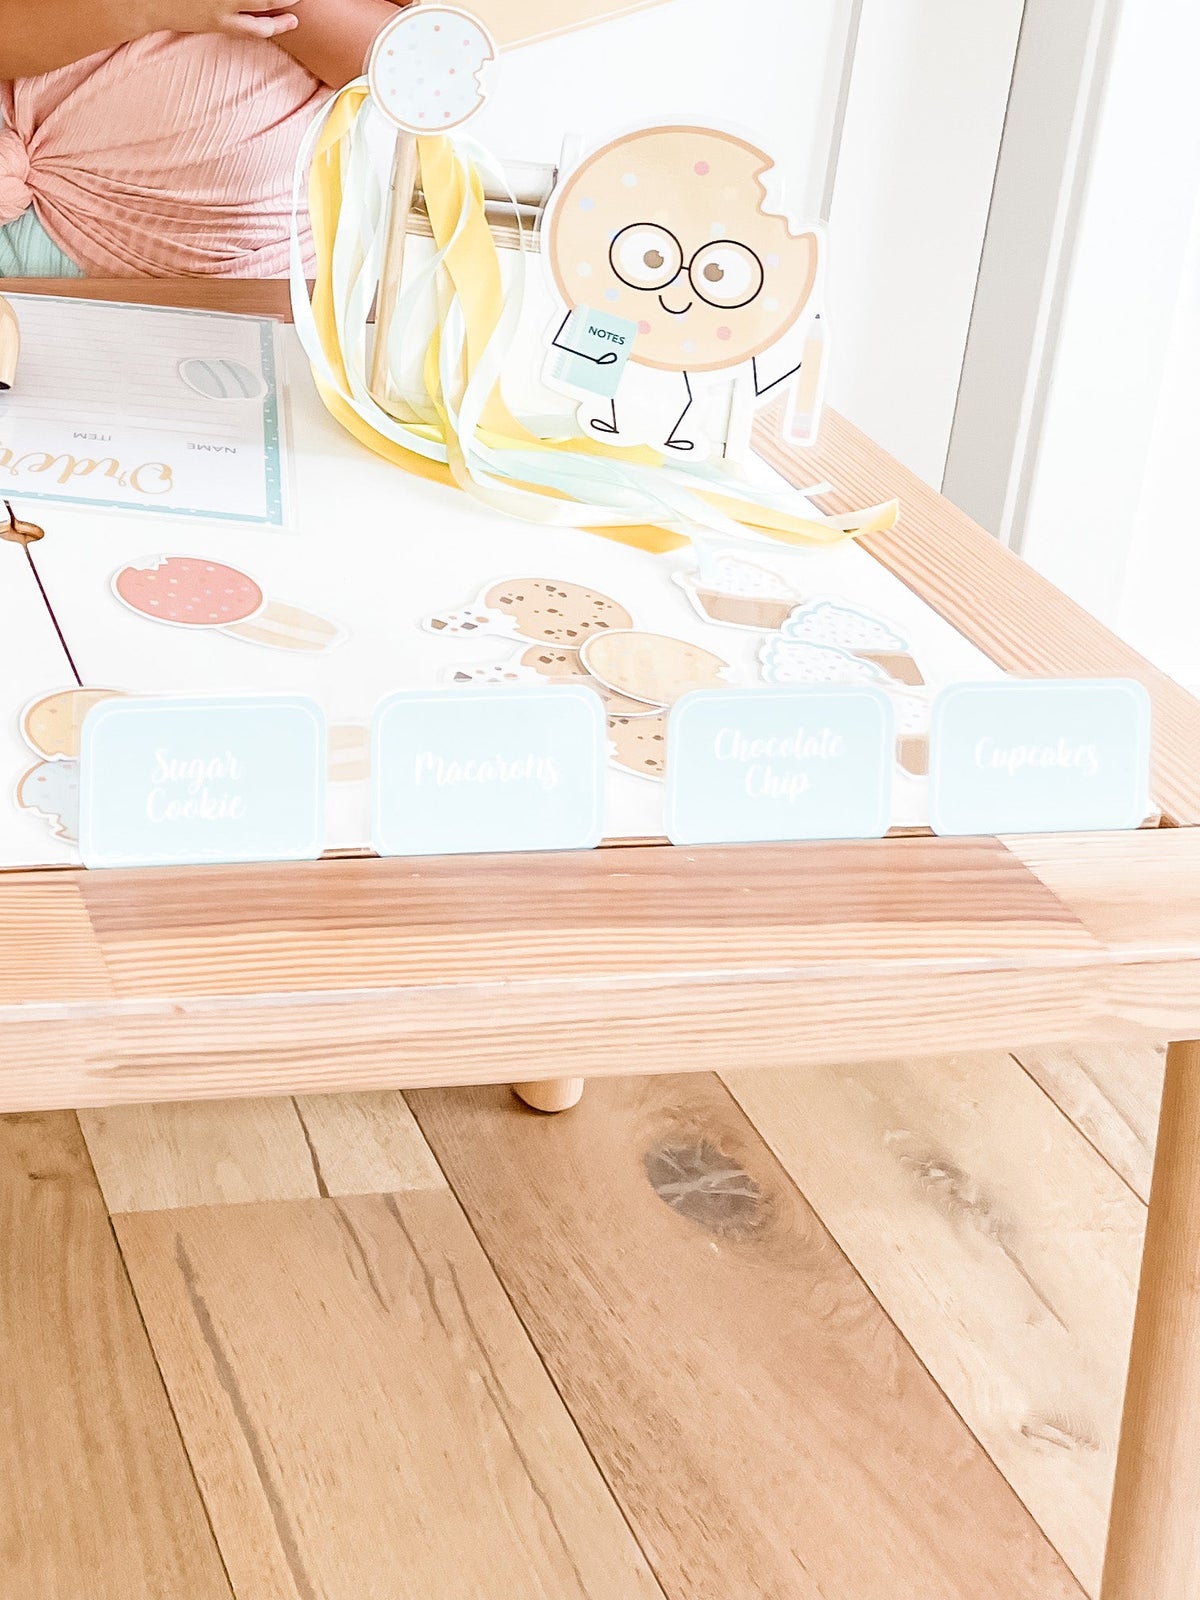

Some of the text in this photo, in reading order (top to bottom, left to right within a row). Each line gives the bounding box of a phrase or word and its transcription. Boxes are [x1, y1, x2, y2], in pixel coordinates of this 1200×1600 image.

[587, 326, 626, 346] NOTES
[73, 431, 112, 442] ITEM
[186, 442, 237, 455] NAME
[714, 727, 845, 763] Chocolate
[975, 737, 1101, 776] Cupcakes
[150, 747, 243, 794] Sugar
[414, 751, 561, 791] Macarons
[745, 763, 814, 804] Chip
[146, 788, 248, 824] Cookie
